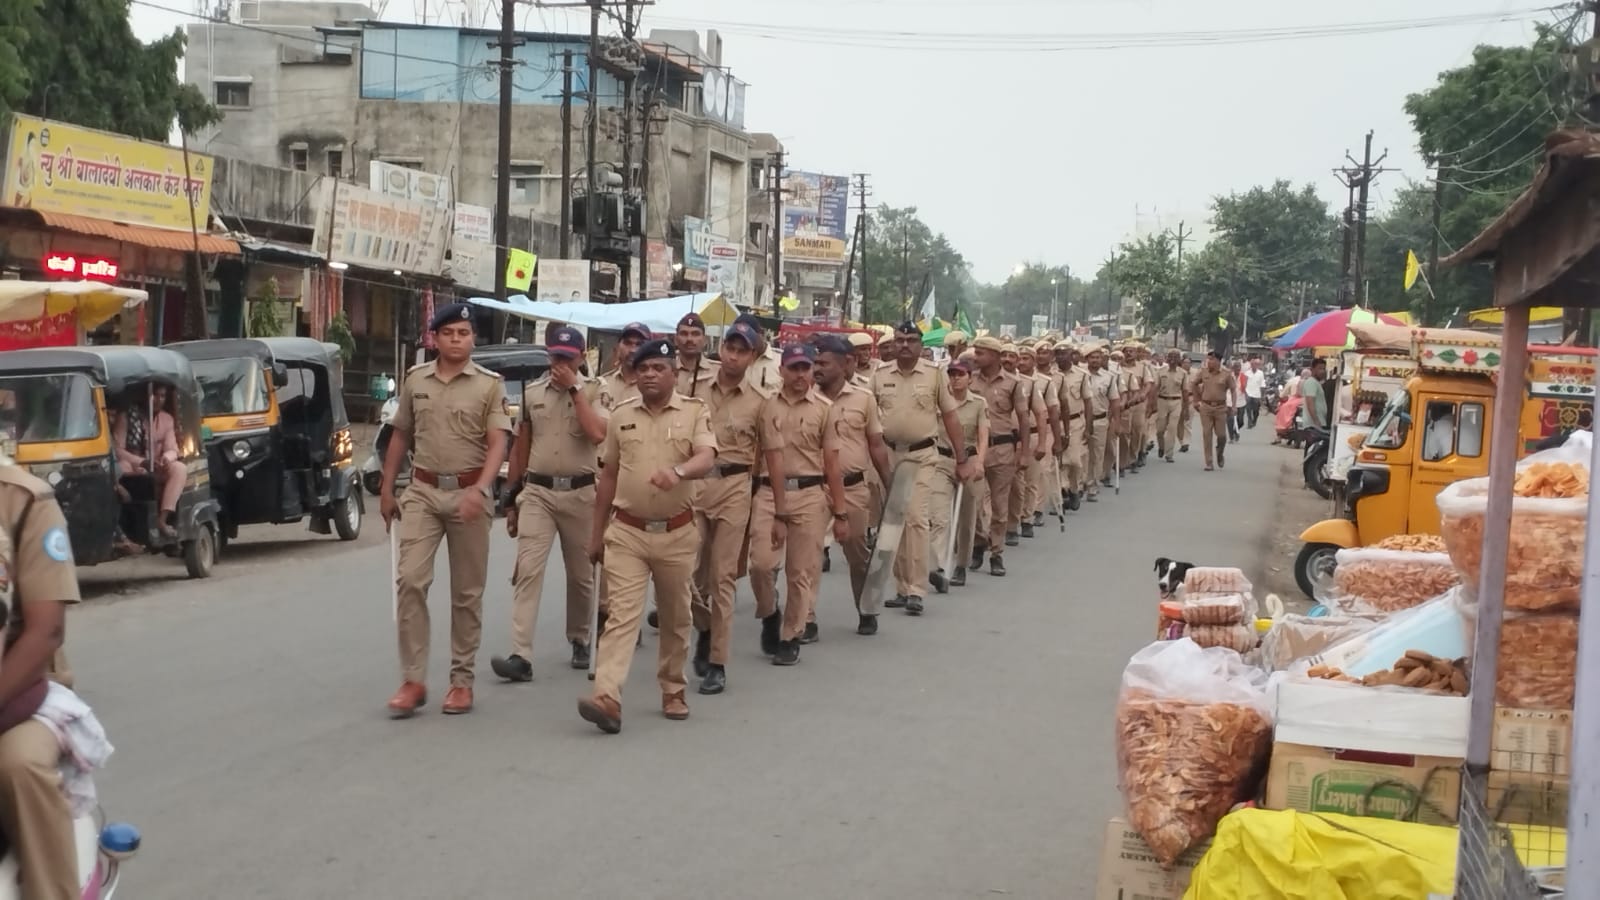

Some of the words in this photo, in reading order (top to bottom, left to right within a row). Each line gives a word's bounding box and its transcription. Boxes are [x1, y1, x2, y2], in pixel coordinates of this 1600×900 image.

[58, 147, 73, 180] श्री
[794, 238, 831, 249] SANMATI
[1318, 782, 1365, 816] Bakery
